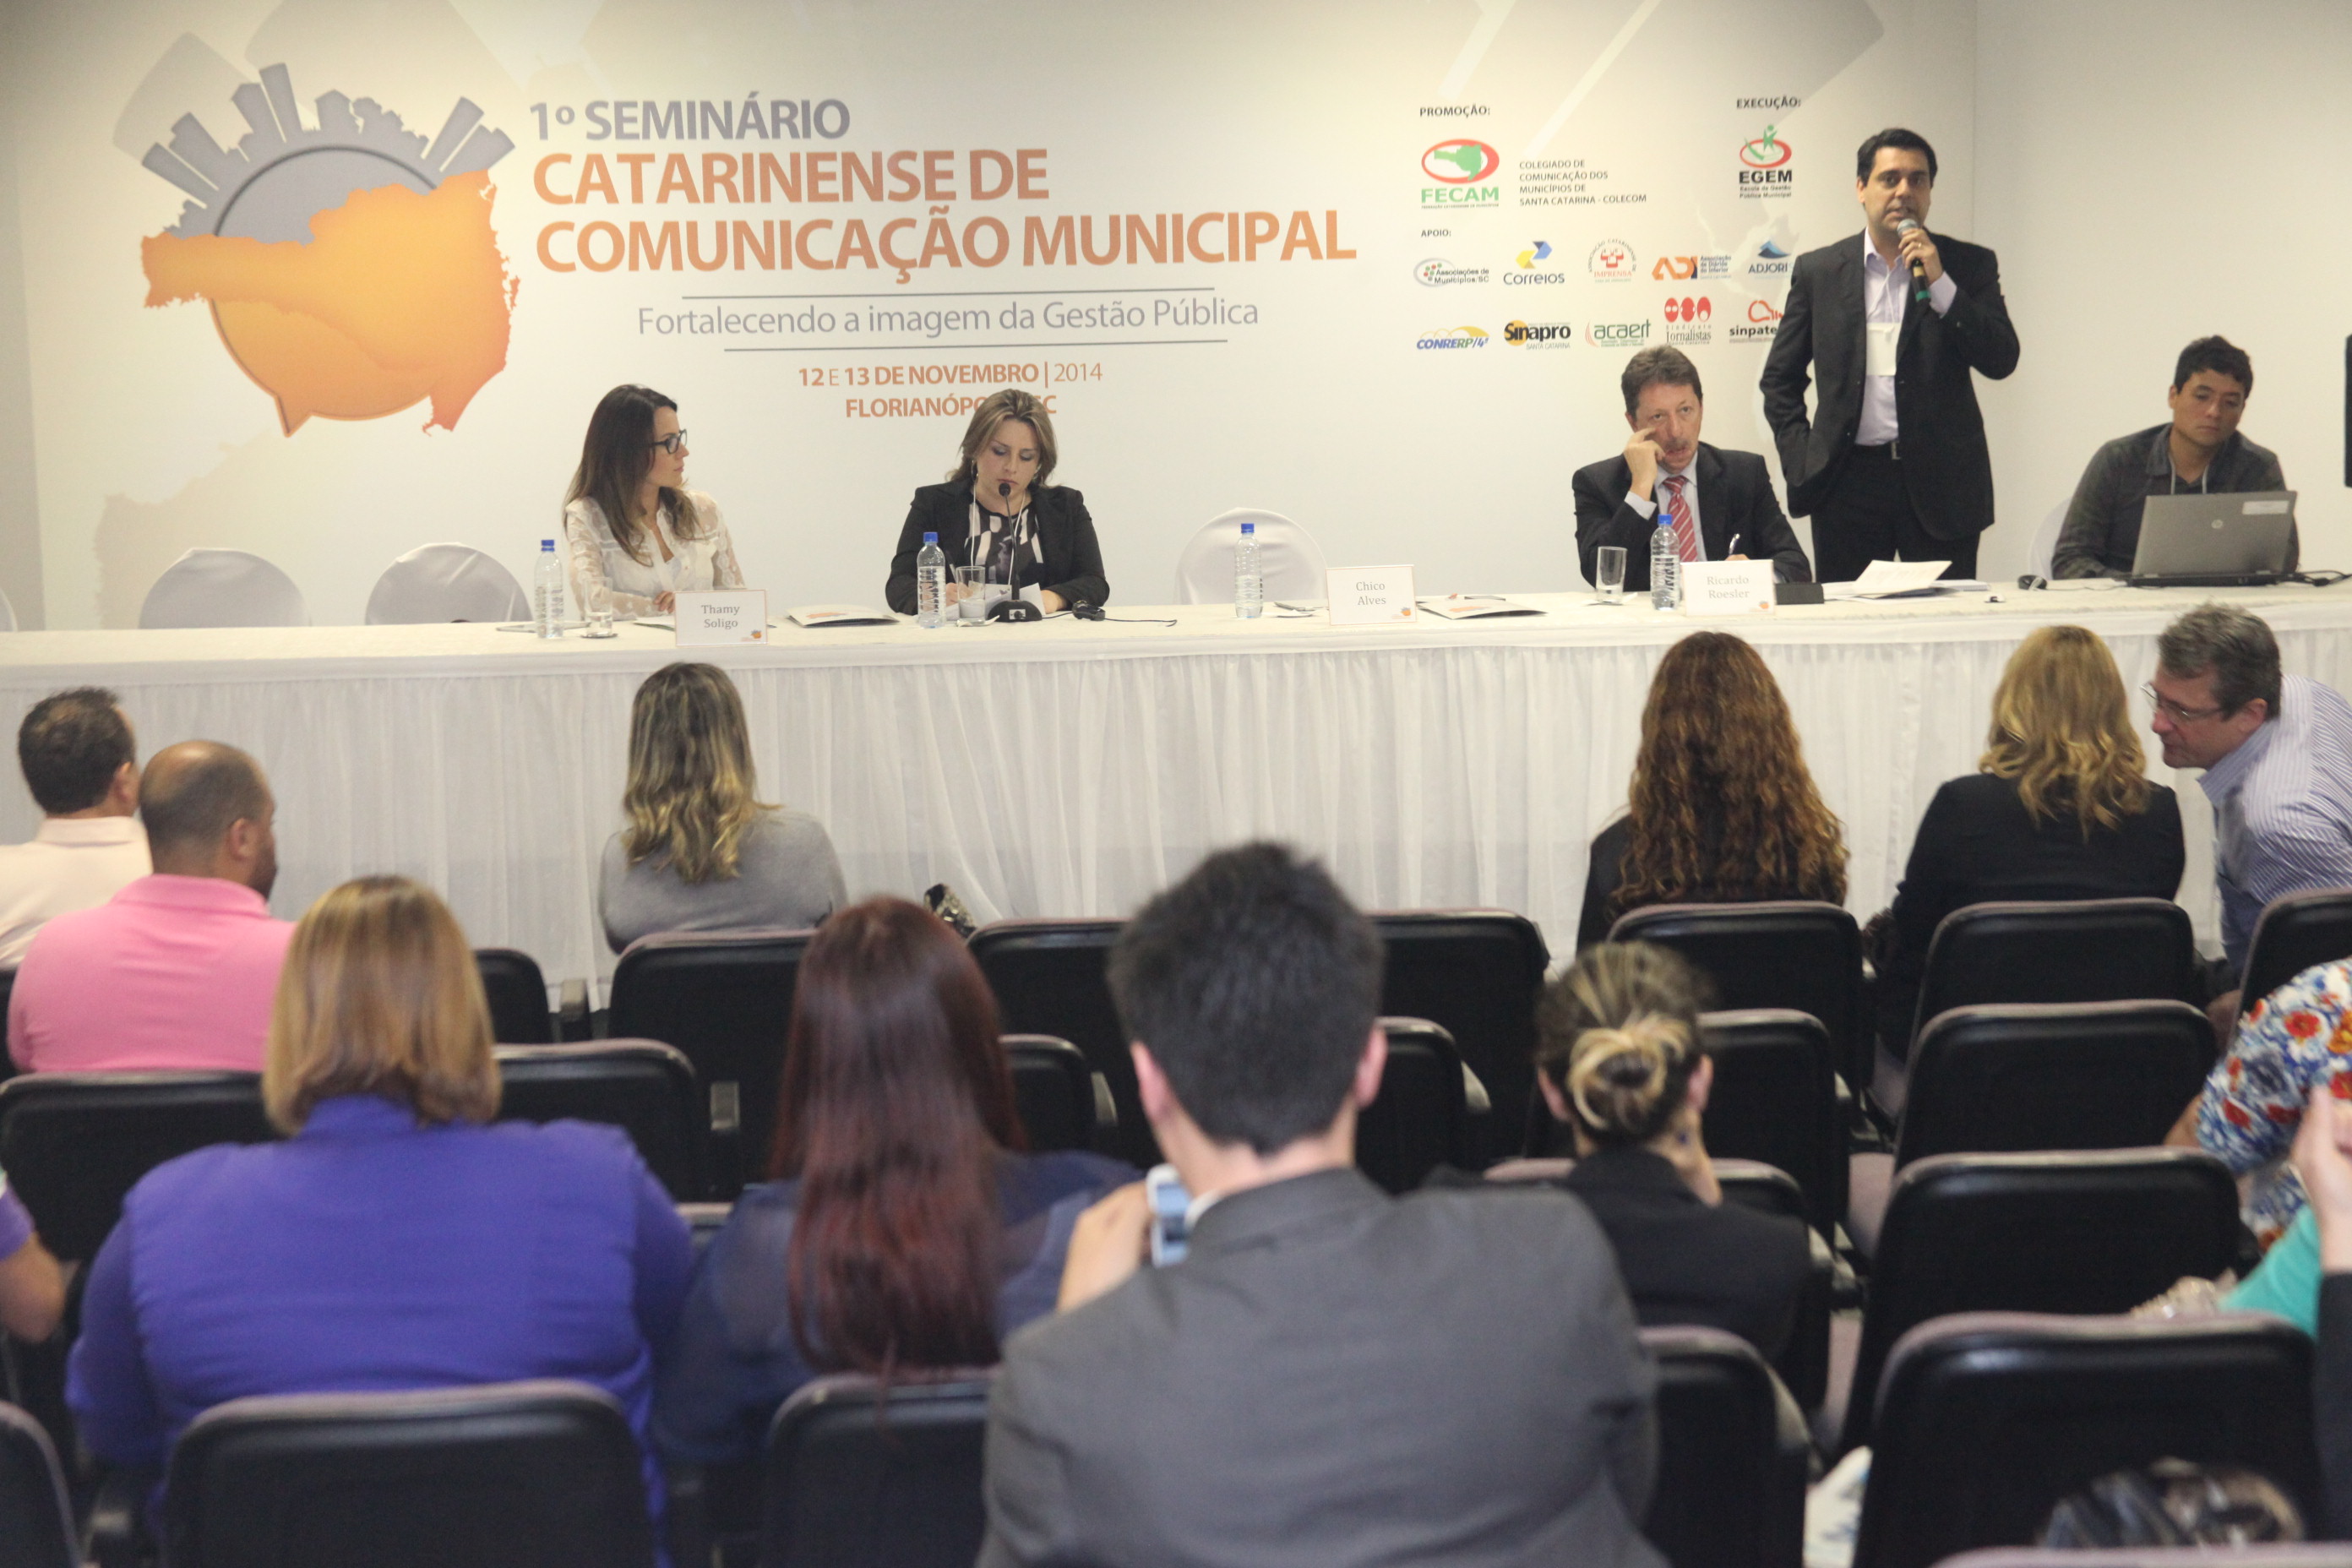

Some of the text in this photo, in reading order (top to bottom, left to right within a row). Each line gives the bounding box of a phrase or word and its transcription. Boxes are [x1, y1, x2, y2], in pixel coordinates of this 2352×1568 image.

[1736, 95, 1801, 111] EXECUÇÃO:
[529, 91, 851, 141] 1º SEMINÁRIO
[1419, 105, 1491, 118] PROMOÇÃO:
[1519, 159, 1586, 170] COLEGIADO DE
[533, 149, 1050, 205] CATARINENSE DE
[1519, 171, 1609, 182] COMUNICAÇÃO DOS
[1739, 170, 1793, 184] EGEM
[1519, 183, 1587, 193] MUNICÍPIOS DE
[1421, 187, 1500, 203] FECAM
[1519, 197, 1549, 206] SANTA
[1551, 195, 1596, 205] CATARINA
[1603, 194, 1647, 204] COLECOM
[1421, 229, 1452, 237] APOIO:
[536, 205, 1357, 284] COMUNICAÇÃO MUNICIPAL
[1436, 268, 1479, 276] Associações
[1652, 256, 1698, 280] ADI
[1748, 263, 1788, 274] ADJORI
[1503, 271, 1565, 286] Correios
[639, 297, 1259, 339] Fortalecendo a imagem da Gestão Pública
[1504, 322, 1571, 342] Sinapro
[1594, 318, 1652, 340] acaert
[1729, 324, 1778, 336] sinpate
[1666, 329, 1712, 343] Jornalistas
[798, 368, 825, 387] 12
[829, 368, 840, 387] E
[844, 367, 869, 386] 13
[874, 366, 904, 385] DE
[909, 363, 1039, 384] NOVEMBRO
[1054, 362, 1103, 383] 2014
[846, 393, 987, 418] FLORIANÓPO
[1355, 581, 1386, 591] Chico
[1707, 575, 1750, 585] Ricardo
[1708, 589, 1750, 599] Roesler
[1358, 596, 1386, 606] Alves
[701, 605, 741, 615] Thamy
[704, 618, 738, 629] Soligo
